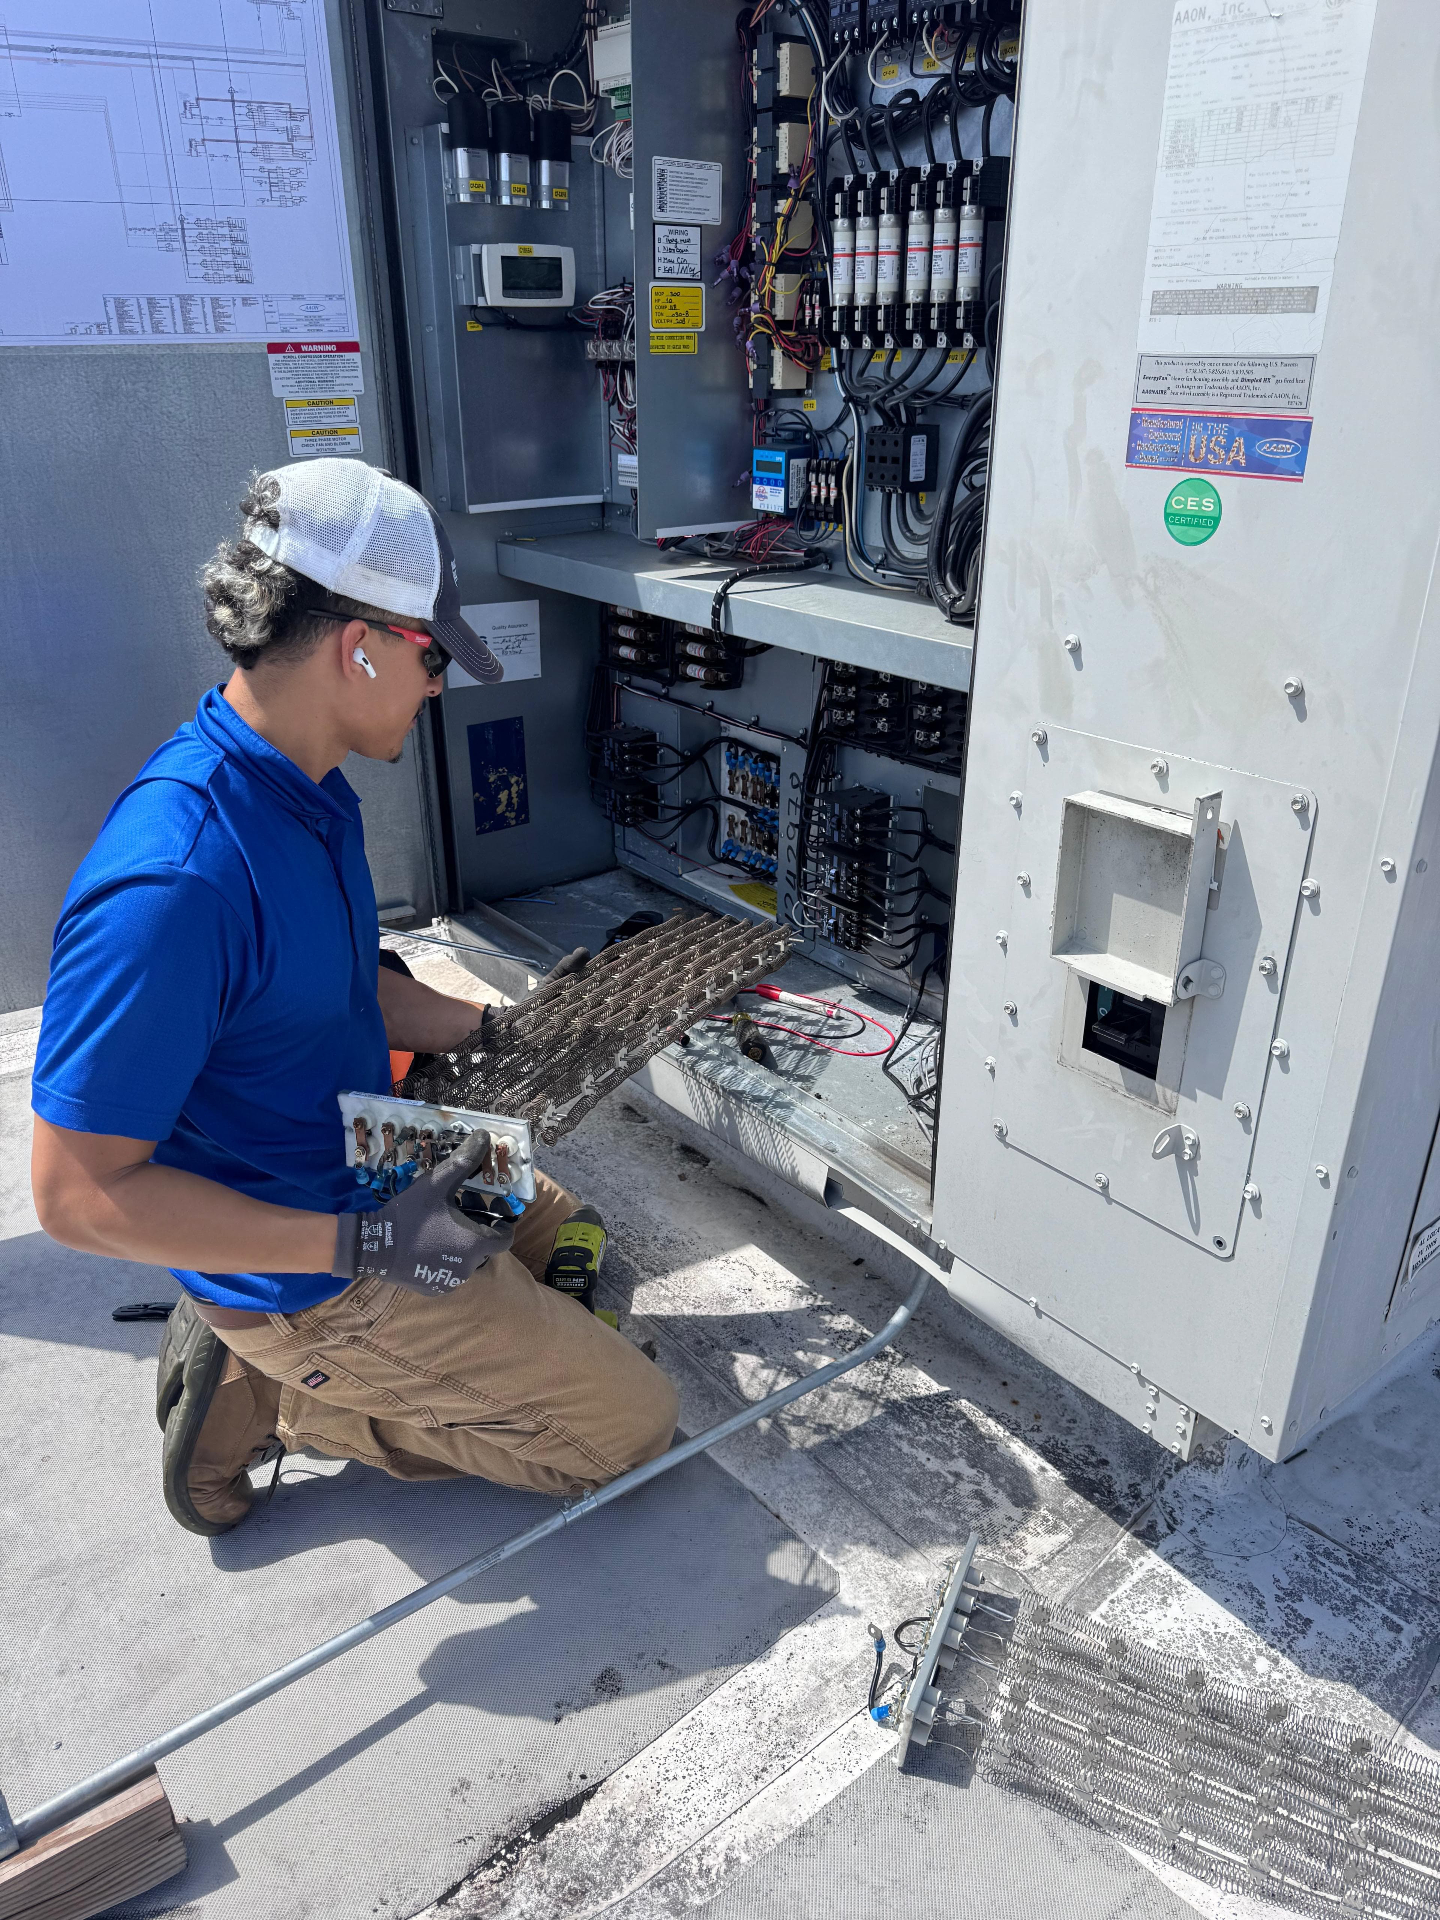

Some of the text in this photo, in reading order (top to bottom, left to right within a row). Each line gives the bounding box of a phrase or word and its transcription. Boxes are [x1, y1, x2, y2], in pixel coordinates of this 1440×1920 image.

[1174, 2, 1250, 26] AAON, Inc.
[300, 344, 337, 352] WARNING
[307, 399, 334, 407] CAUTION
[1141, 416, 1184, 430] Manufactured
[1191, 421, 1230, 436] IN THE
[1148, 429, 1183, 443] Engineered
[1188, 433, 1247, 467] USA
[1261, 443, 1296, 453] AAON
[1171, 496, 1215, 512] CES
[1168, 515, 1214, 527] CERTIFIED
[384, 1220, 394, 1248] Ansell
[441, 1254, 463, 1264] 11-840
